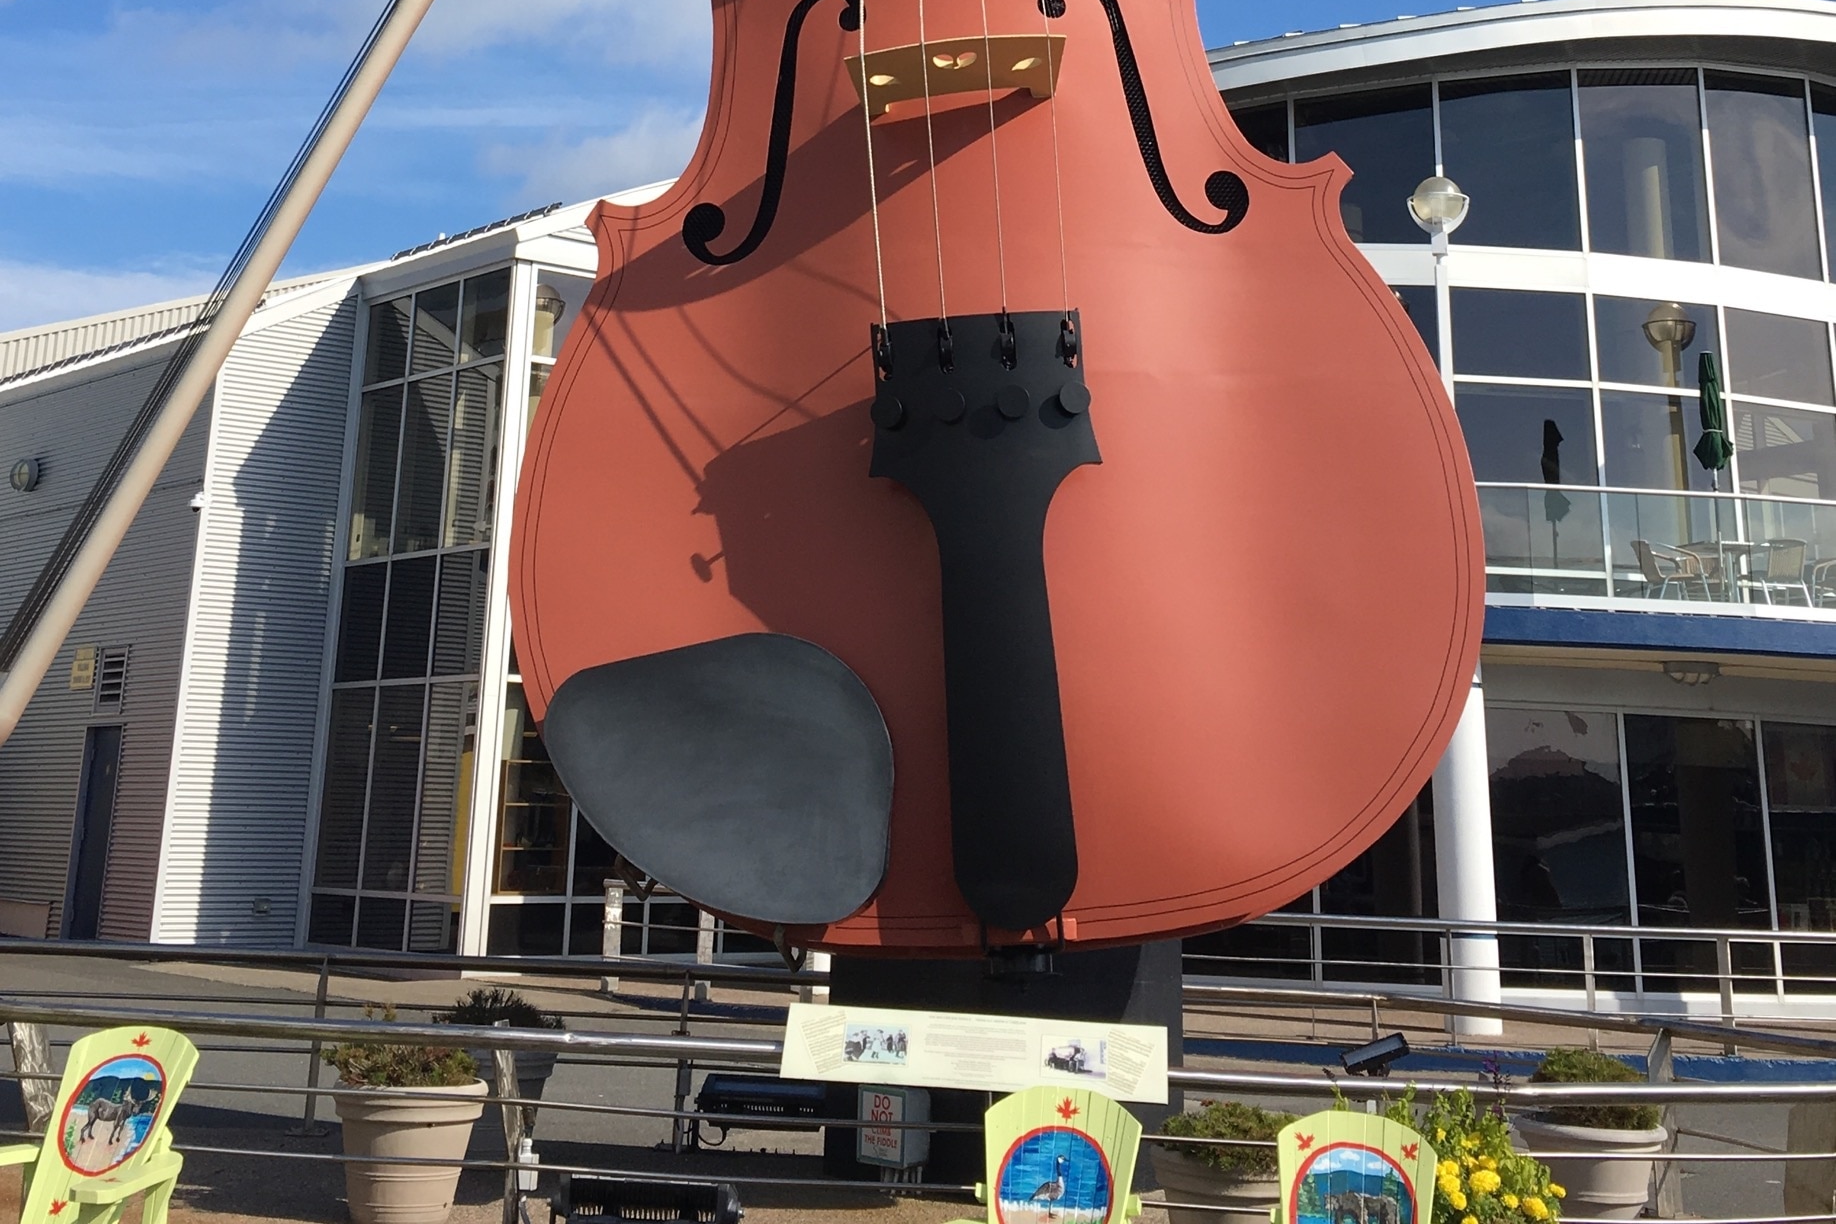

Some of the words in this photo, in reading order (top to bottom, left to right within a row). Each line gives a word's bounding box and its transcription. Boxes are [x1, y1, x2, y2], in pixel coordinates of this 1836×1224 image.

[874, 1094, 891, 1110] DO
[871, 1109, 893, 1122] NOT
[864, 1134, 875, 1145] THE
[877, 1136, 897, 1148] FIDDLE
